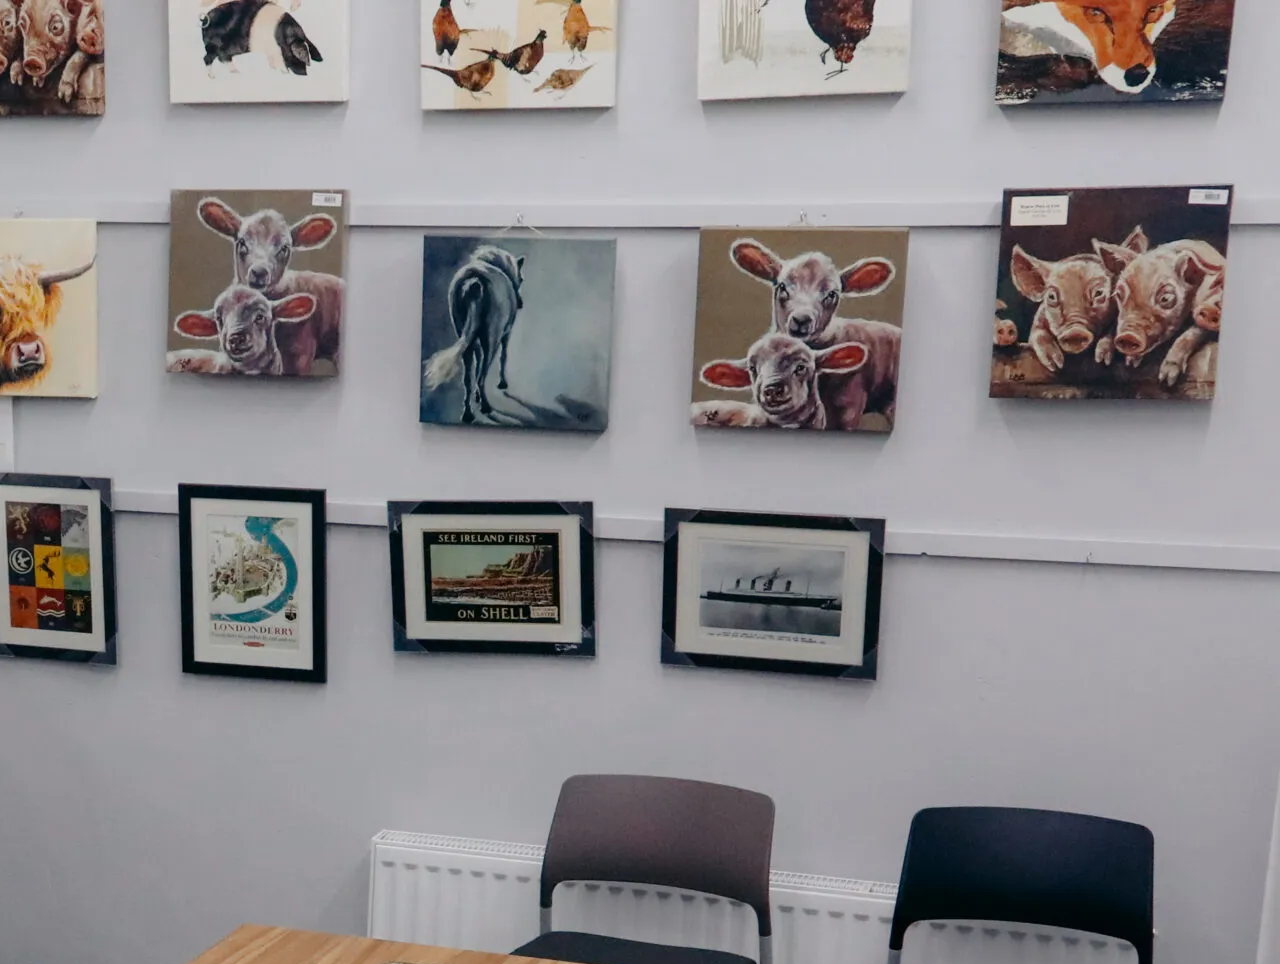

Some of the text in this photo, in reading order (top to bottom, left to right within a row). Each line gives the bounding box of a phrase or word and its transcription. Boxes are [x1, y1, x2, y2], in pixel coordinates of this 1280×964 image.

[438, 534, 537, 544] SEE IRELAND FIRST
[458, 609, 475, 619] ON
[480, 607, 529, 620] SHELL
[213, 622, 295, 636] LONDONDERRY
